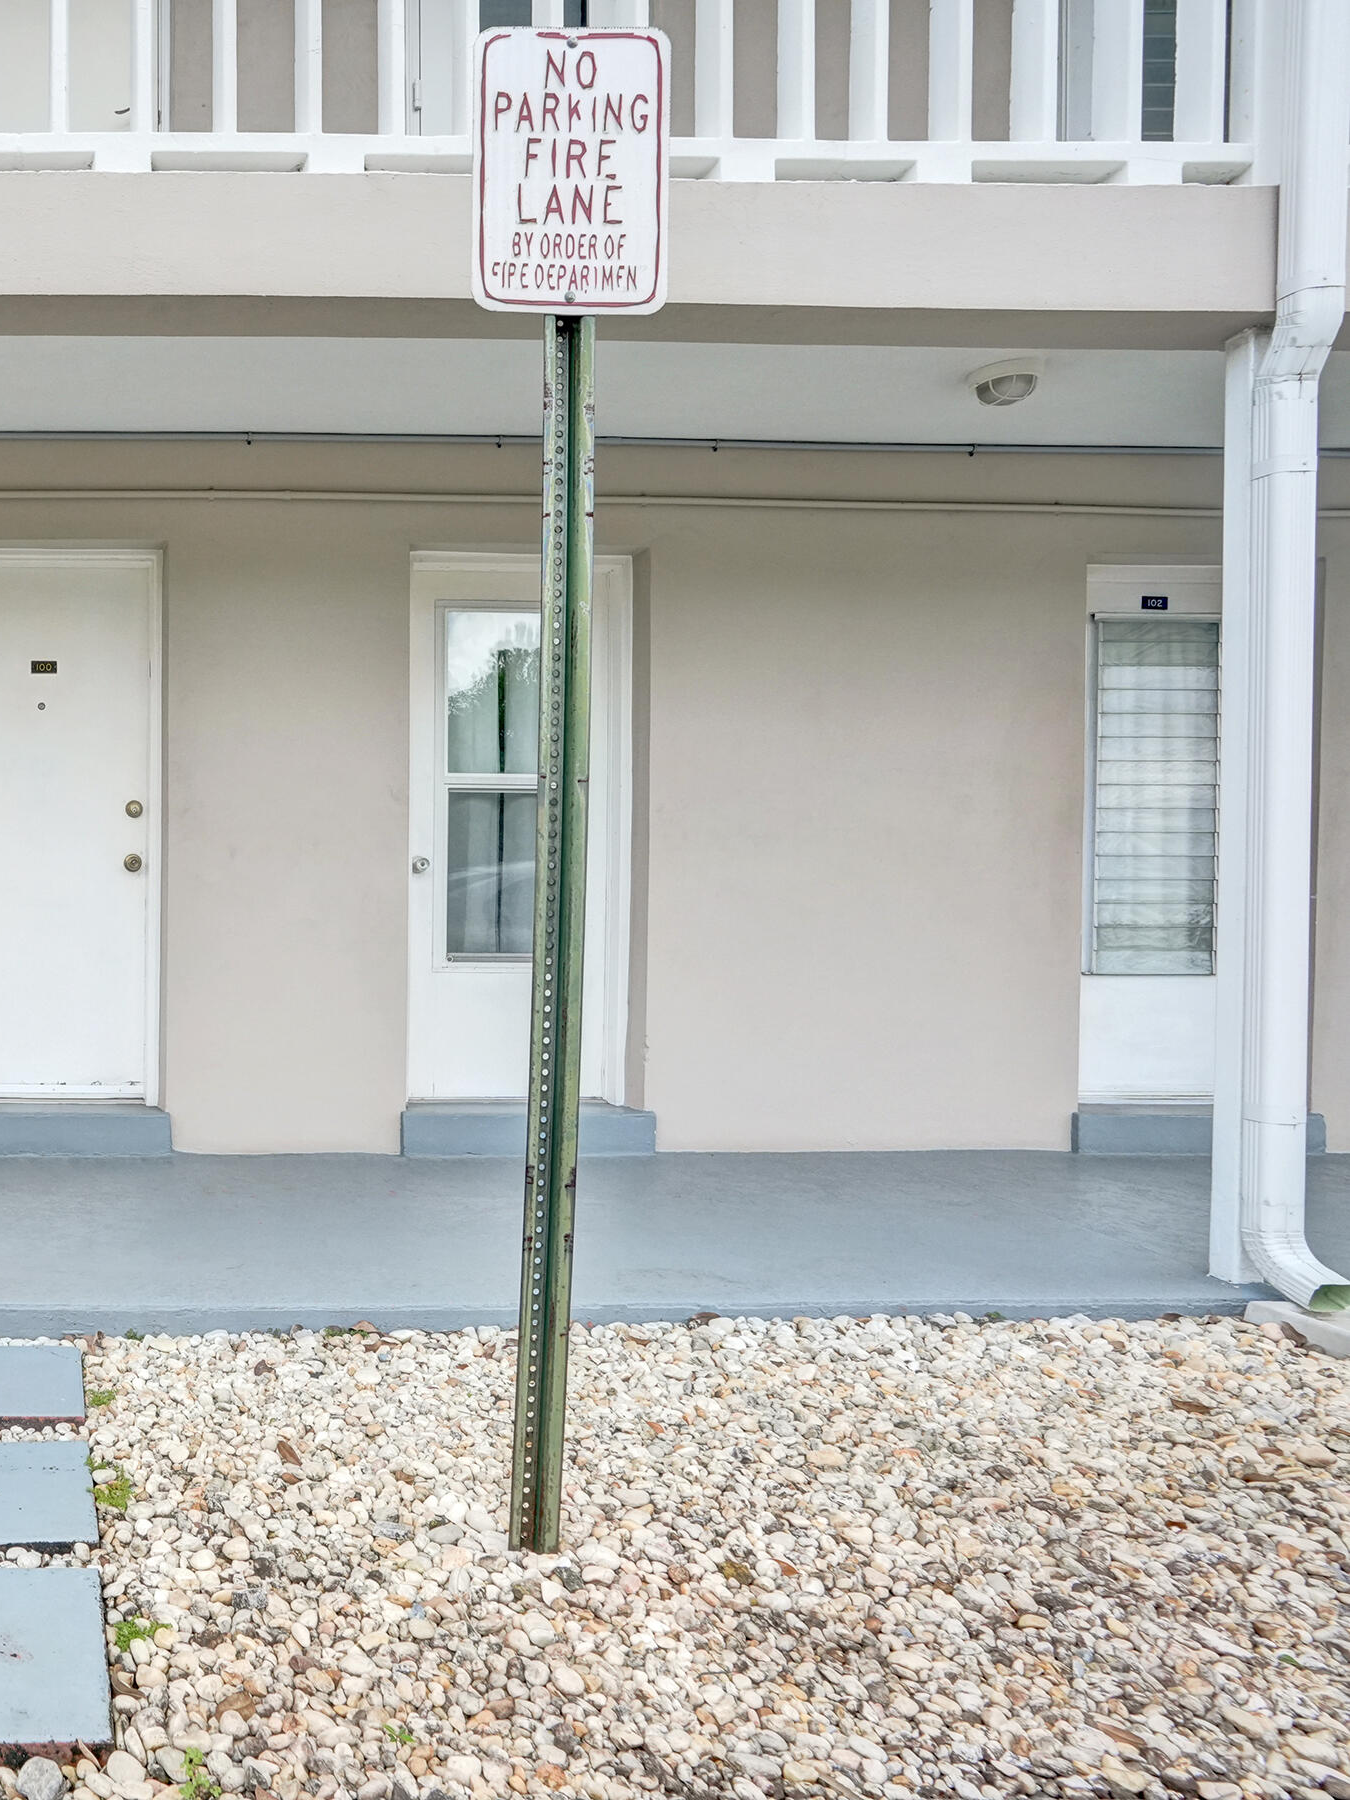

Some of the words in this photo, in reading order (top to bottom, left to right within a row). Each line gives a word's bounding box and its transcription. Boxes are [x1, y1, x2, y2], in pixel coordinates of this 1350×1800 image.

[544, 49, 598, 90] NO
[494, 91, 649, 134] PARKING
[525, 137, 617, 181] FIRE
[517, 183, 623, 225] LANE
[512, 231, 534, 257] BY
[540, 232, 598, 260] ORDER
[604, 233, 627, 259] OF
[1147, 599, 1163, 607] 102
[36, 663, 52, 671] 100
